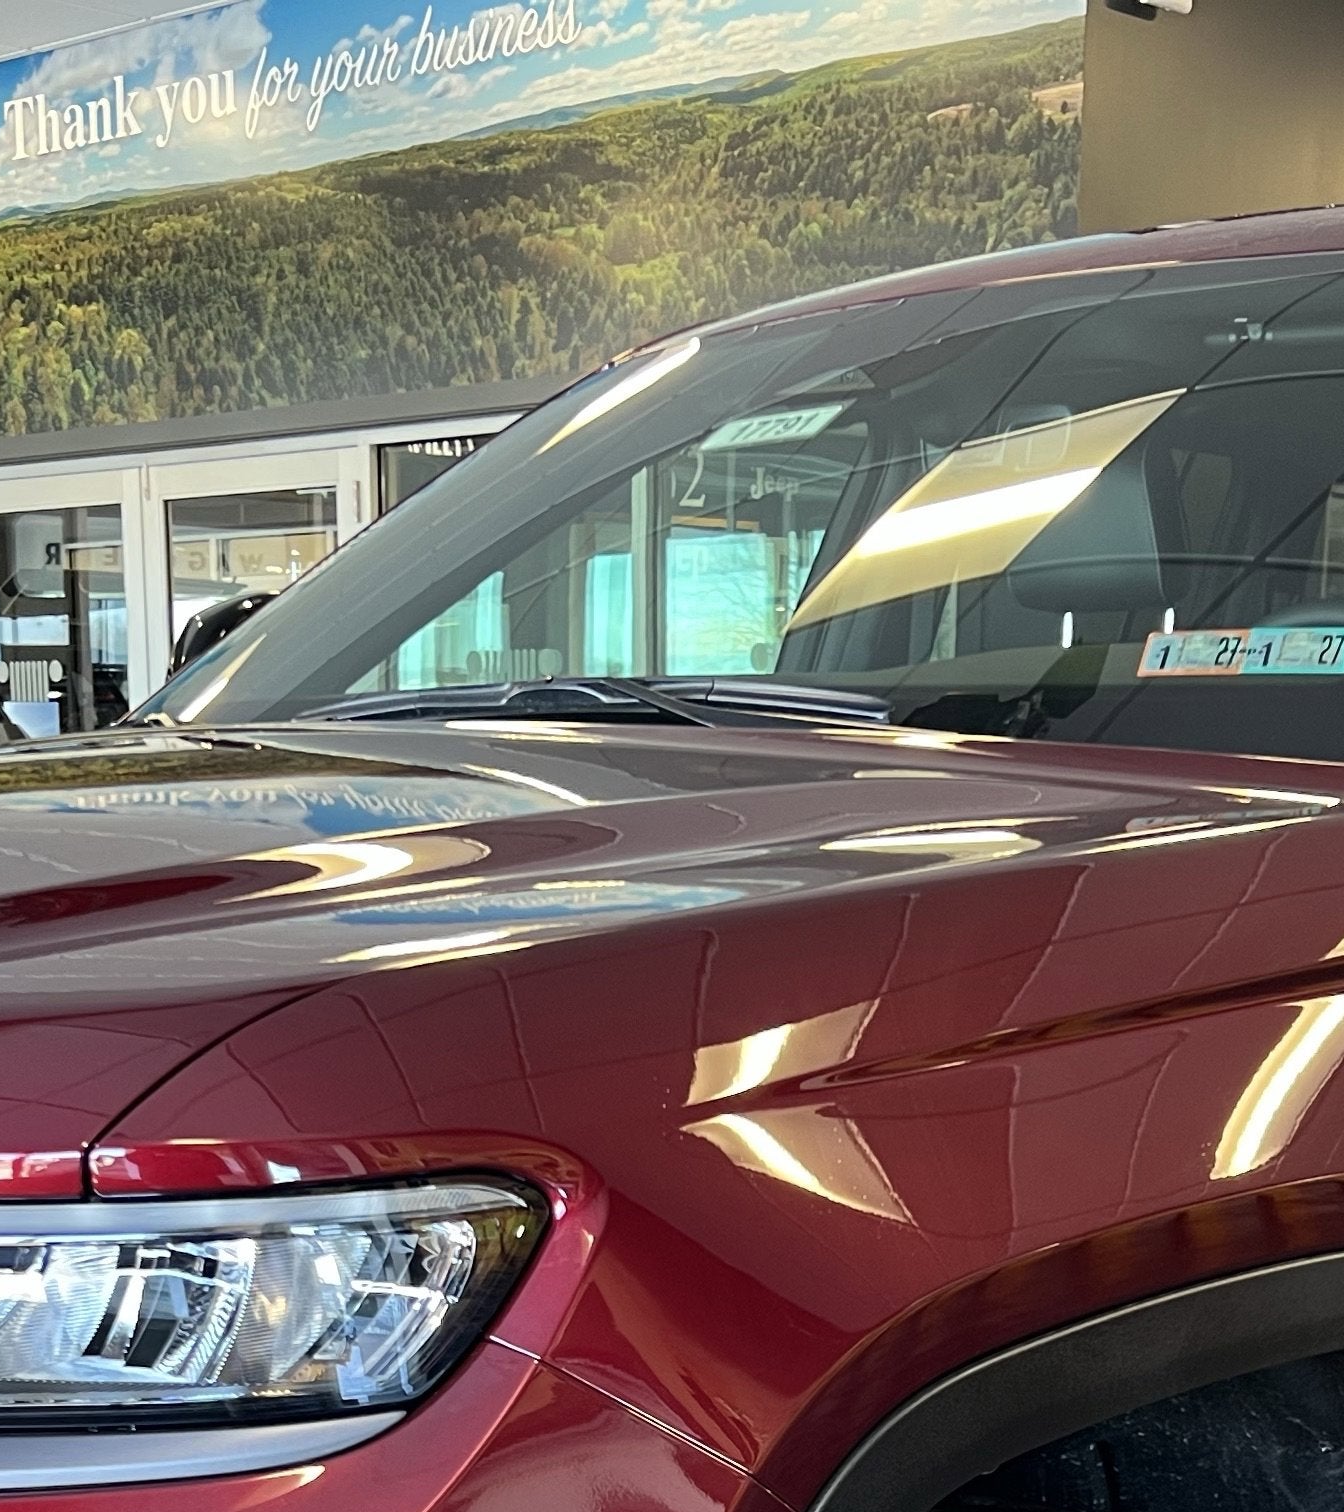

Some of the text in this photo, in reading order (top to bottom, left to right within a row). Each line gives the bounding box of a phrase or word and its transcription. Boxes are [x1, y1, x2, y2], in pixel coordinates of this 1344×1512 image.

[3, 1, 582, 161] Thank you for your business
[1214, 636, 1242, 669] 27
